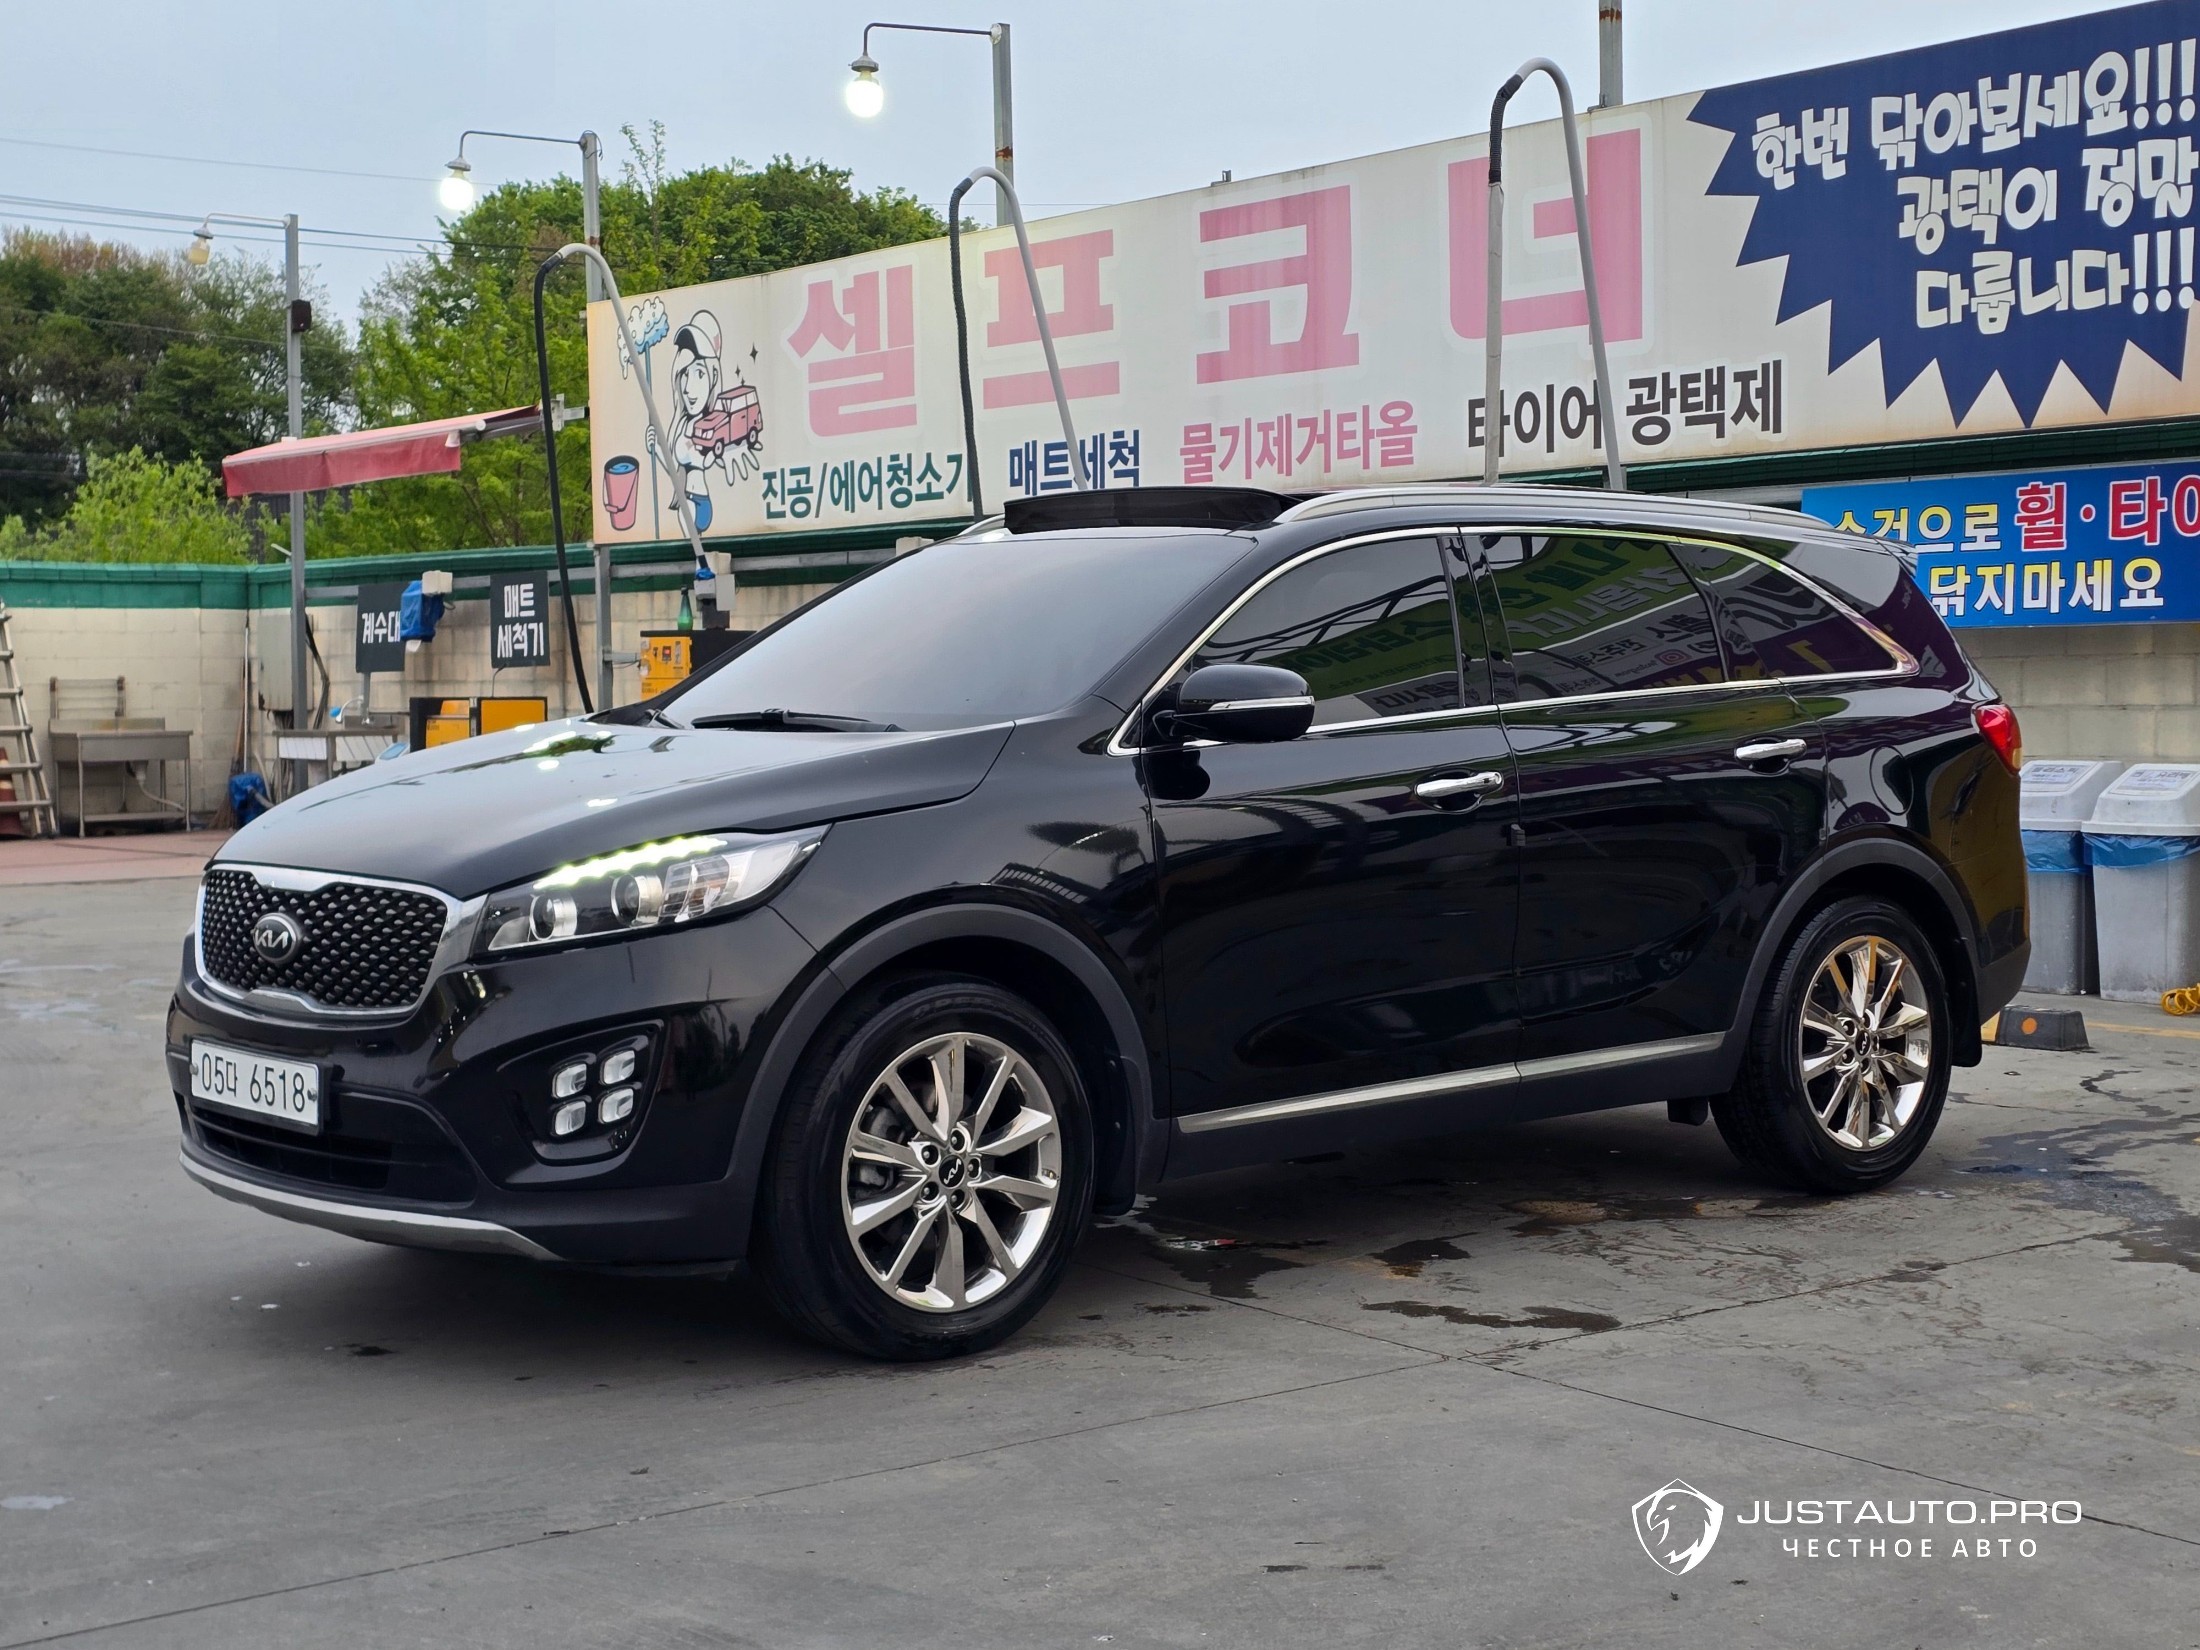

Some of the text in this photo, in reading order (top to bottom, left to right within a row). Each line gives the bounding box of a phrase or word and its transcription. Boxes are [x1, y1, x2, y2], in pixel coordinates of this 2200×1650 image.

[1752, 38, 2197, 190] 한번 닦아보세요!!!
[1897, 136, 2200, 255] 광택이 정말
[1916, 226, 2196, 334] 다릅니다!!!
[1179, 399, 1419, 484] 물기제거타올
[1468, 359, 1782, 458] 타이어 광택제
[762, 452, 973, 519] 진공/에어청소기
[1009, 429, 1141, 495] 매트세척
[503, 583, 536, 618] 매트
[1929, 557, 2164, 616] 닦지마세요
[497, 622, 545, 658] 세척기
[201, 1052, 305, 1113] 05다 6518
